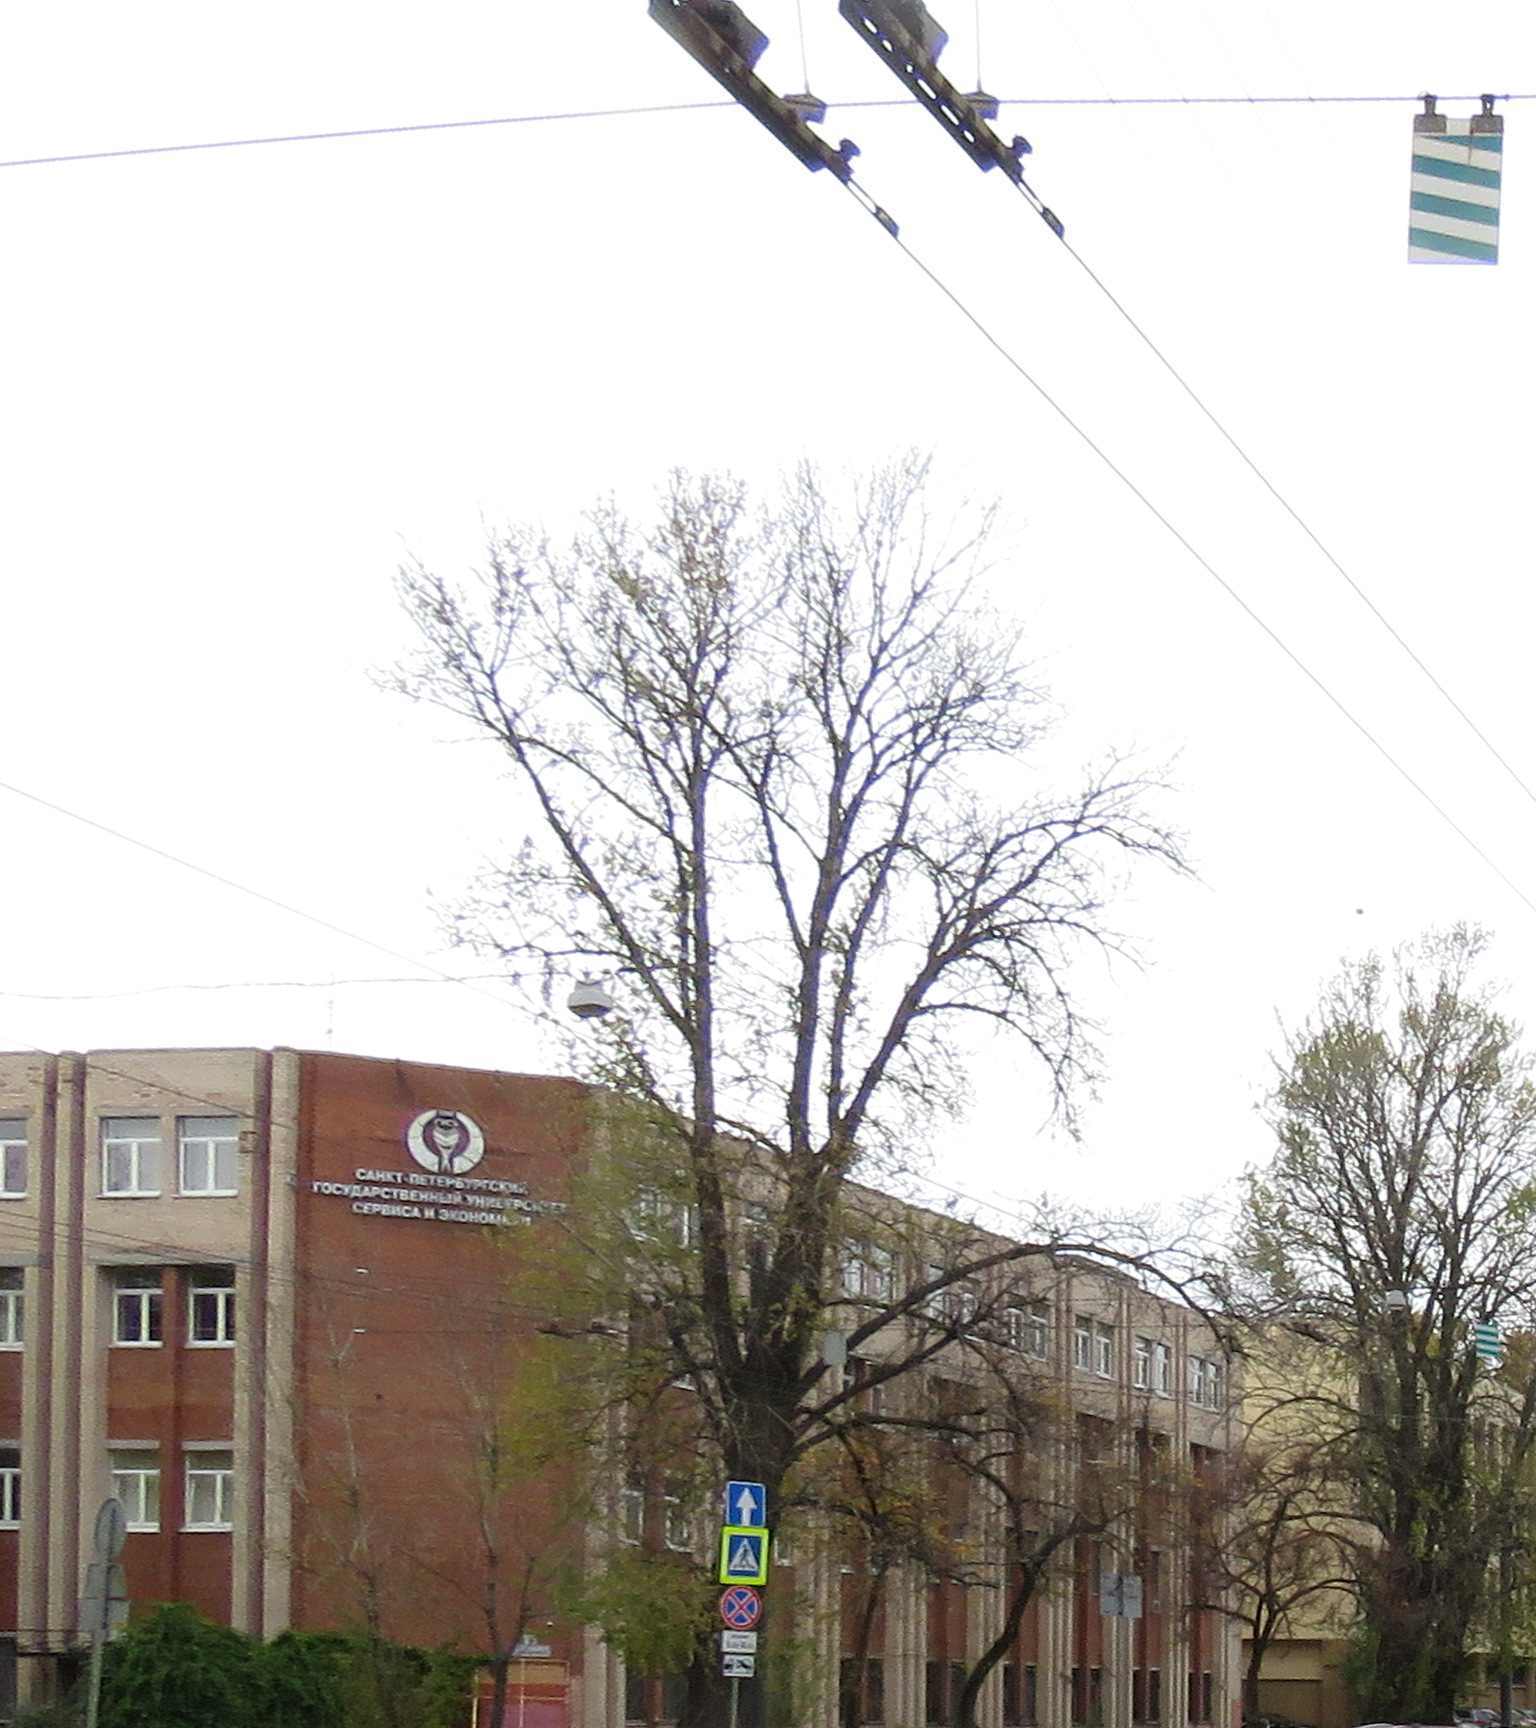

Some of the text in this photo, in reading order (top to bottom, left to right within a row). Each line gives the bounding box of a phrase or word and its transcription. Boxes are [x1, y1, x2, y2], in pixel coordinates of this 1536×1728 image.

[312, 1180, 461, 1205] ГОСУДАРСТВЕННЫЙ
[352, 1201, 421, 1218] СЕРВИСА
[438, 1208, 532, 1227] ЭКОНОМИ
